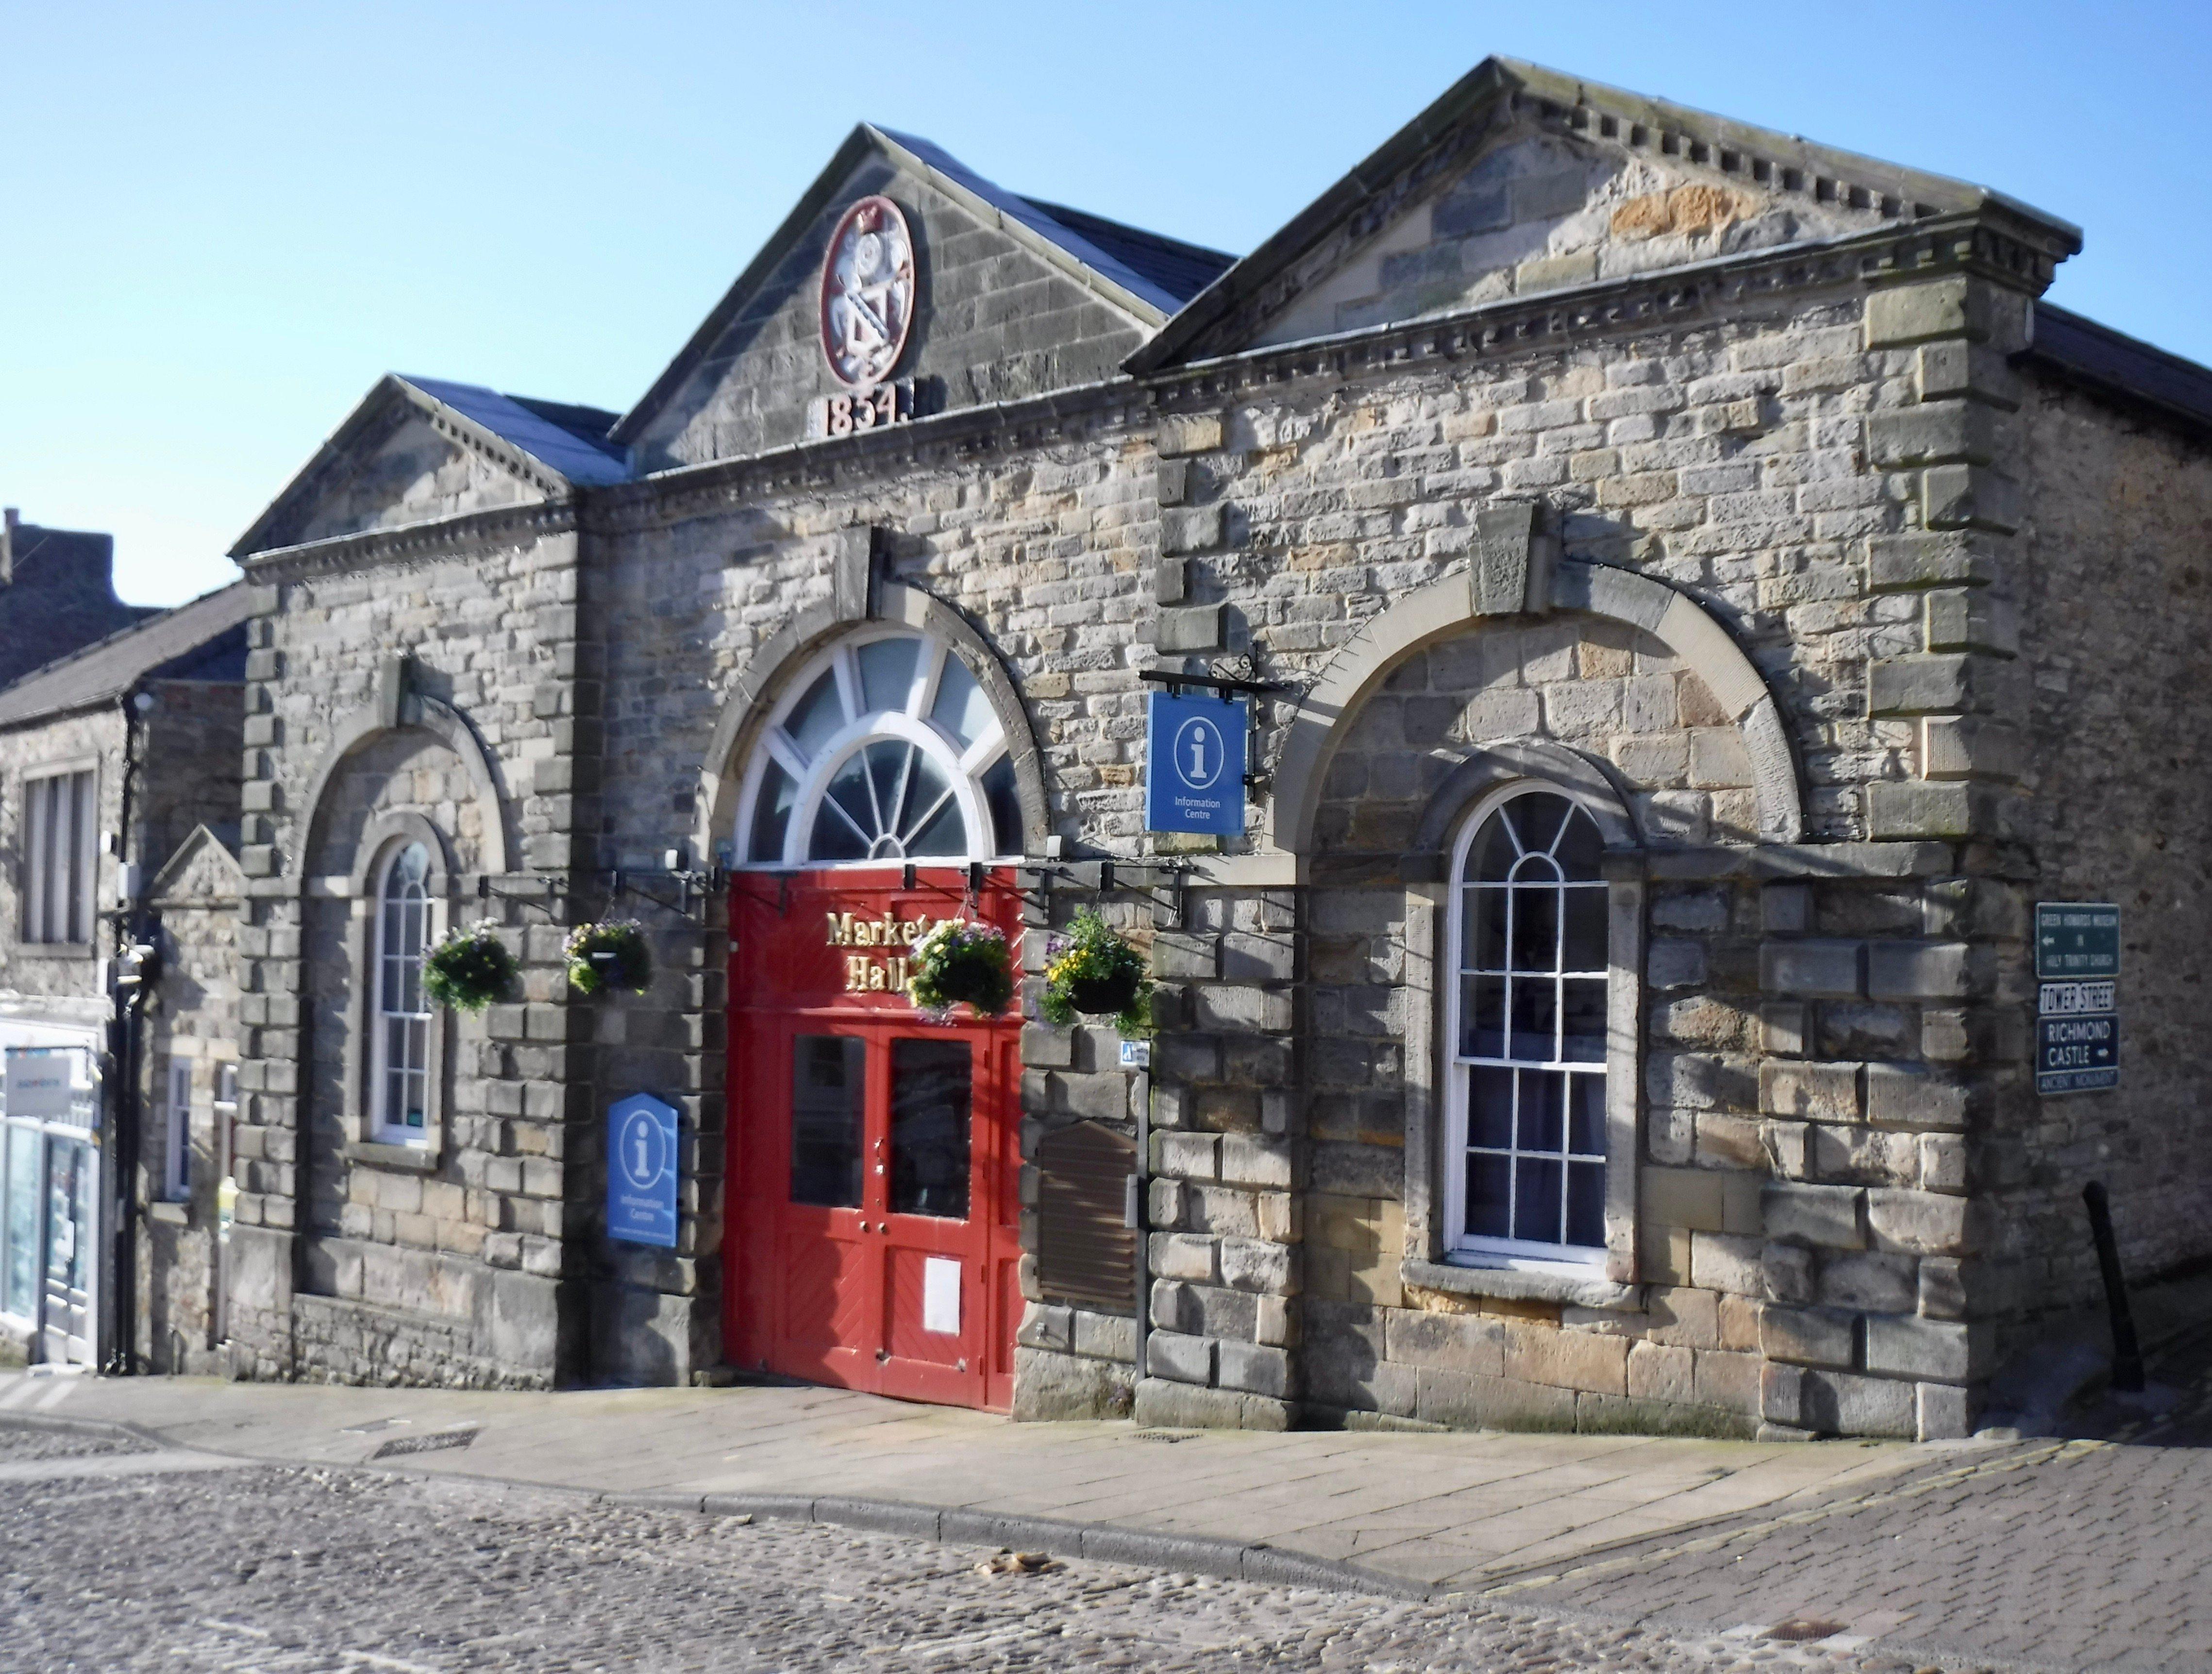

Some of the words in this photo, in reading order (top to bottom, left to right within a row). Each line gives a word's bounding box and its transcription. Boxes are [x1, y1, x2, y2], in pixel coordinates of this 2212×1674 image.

[1175, 796, 1221, 808] Information
[1185, 808, 1211, 820] Centre
[845, 955, 908, 991] Hall
[2043, 987, 2077, 1010] TOWER
[2080, 984, 2113, 1008] STREET
[2048, 1021, 2111, 1041] RICHMOND
[2048, 1045, 2090, 1067] CASTLE
